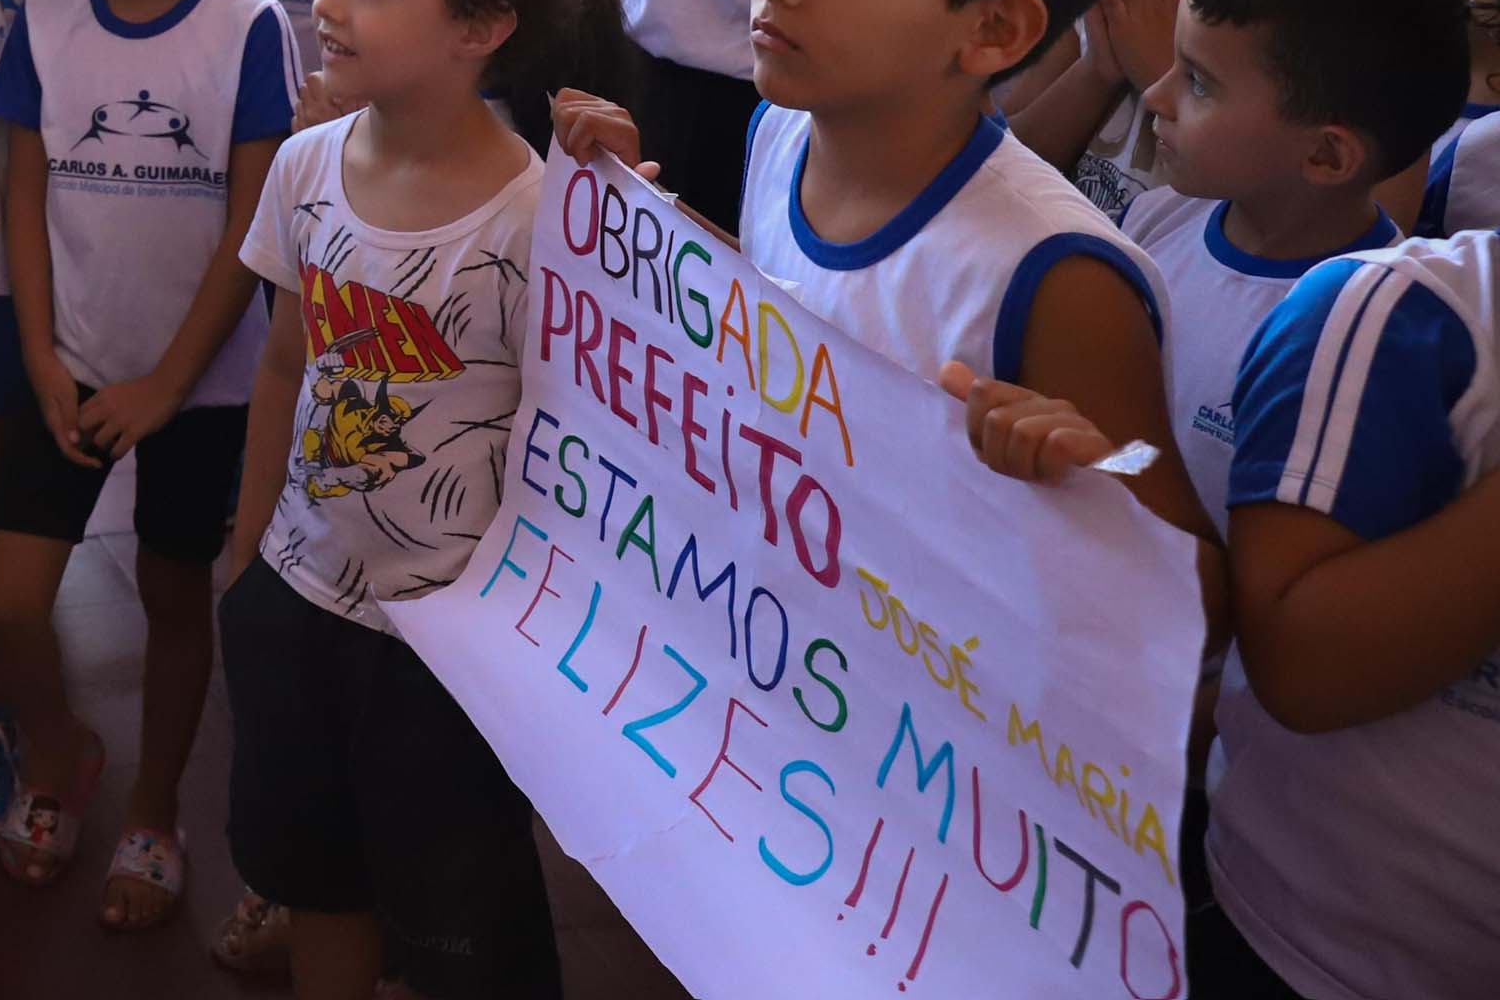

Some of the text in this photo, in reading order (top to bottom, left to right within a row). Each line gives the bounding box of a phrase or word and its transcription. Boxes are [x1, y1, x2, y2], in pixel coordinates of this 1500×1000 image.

[48, 158, 107, 177] CARLOS
[112, 164, 129, 178] A.
[563, 168, 854, 467] OBRIGADA
[479, 514, 949, 992] FELIZES!!!
[522, 408, 1181, 1000] ESTAMOS MUITO
[857, 566, 988, 722] JOSÉ
